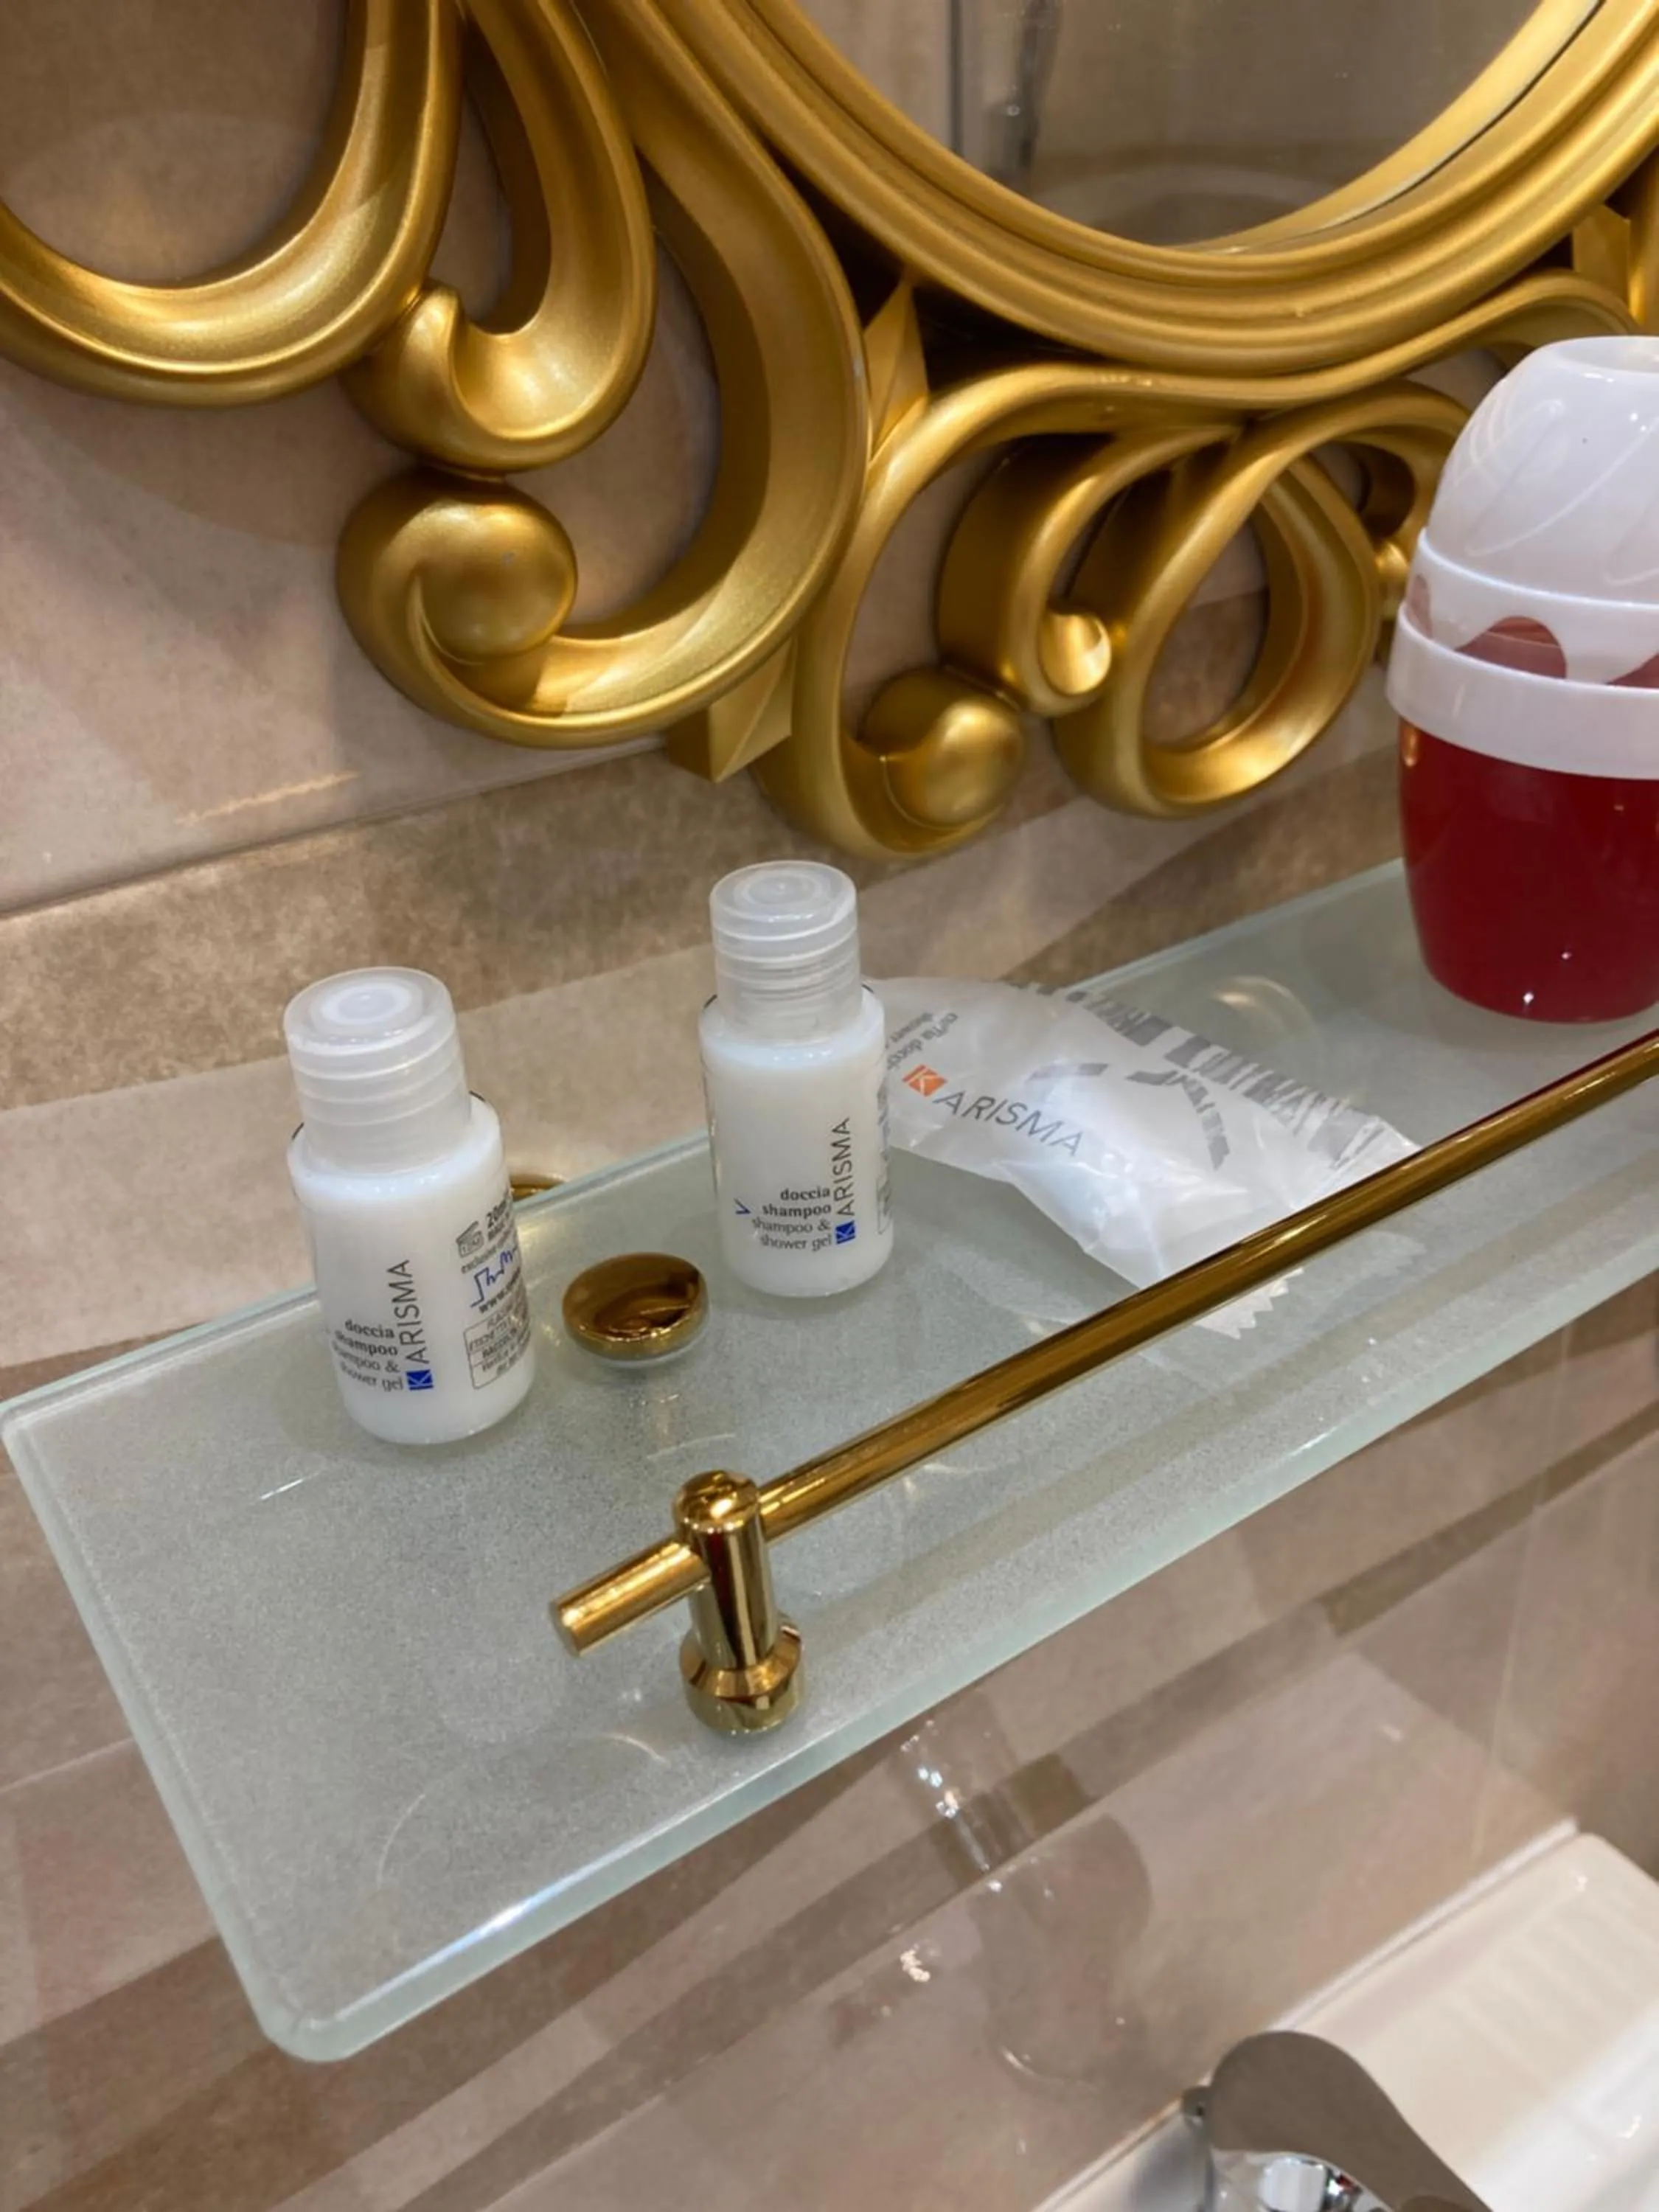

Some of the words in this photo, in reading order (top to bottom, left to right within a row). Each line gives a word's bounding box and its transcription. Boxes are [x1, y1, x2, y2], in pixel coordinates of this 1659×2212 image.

[780, 1186, 831, 1201] doccia
[762, 1203, 832, 1220] shampoo
[751, 1217, 813, 1236] shampoo
[817, 1219, 832, 1231] &
[759, 1234, 807, 1250] shower
[811, 1234, 832, 1252] gel
[344, 1318, 394, 1339] doccia
[385, 1360, 400, 1372] &
[381, 1376, 403, 1393] gel
